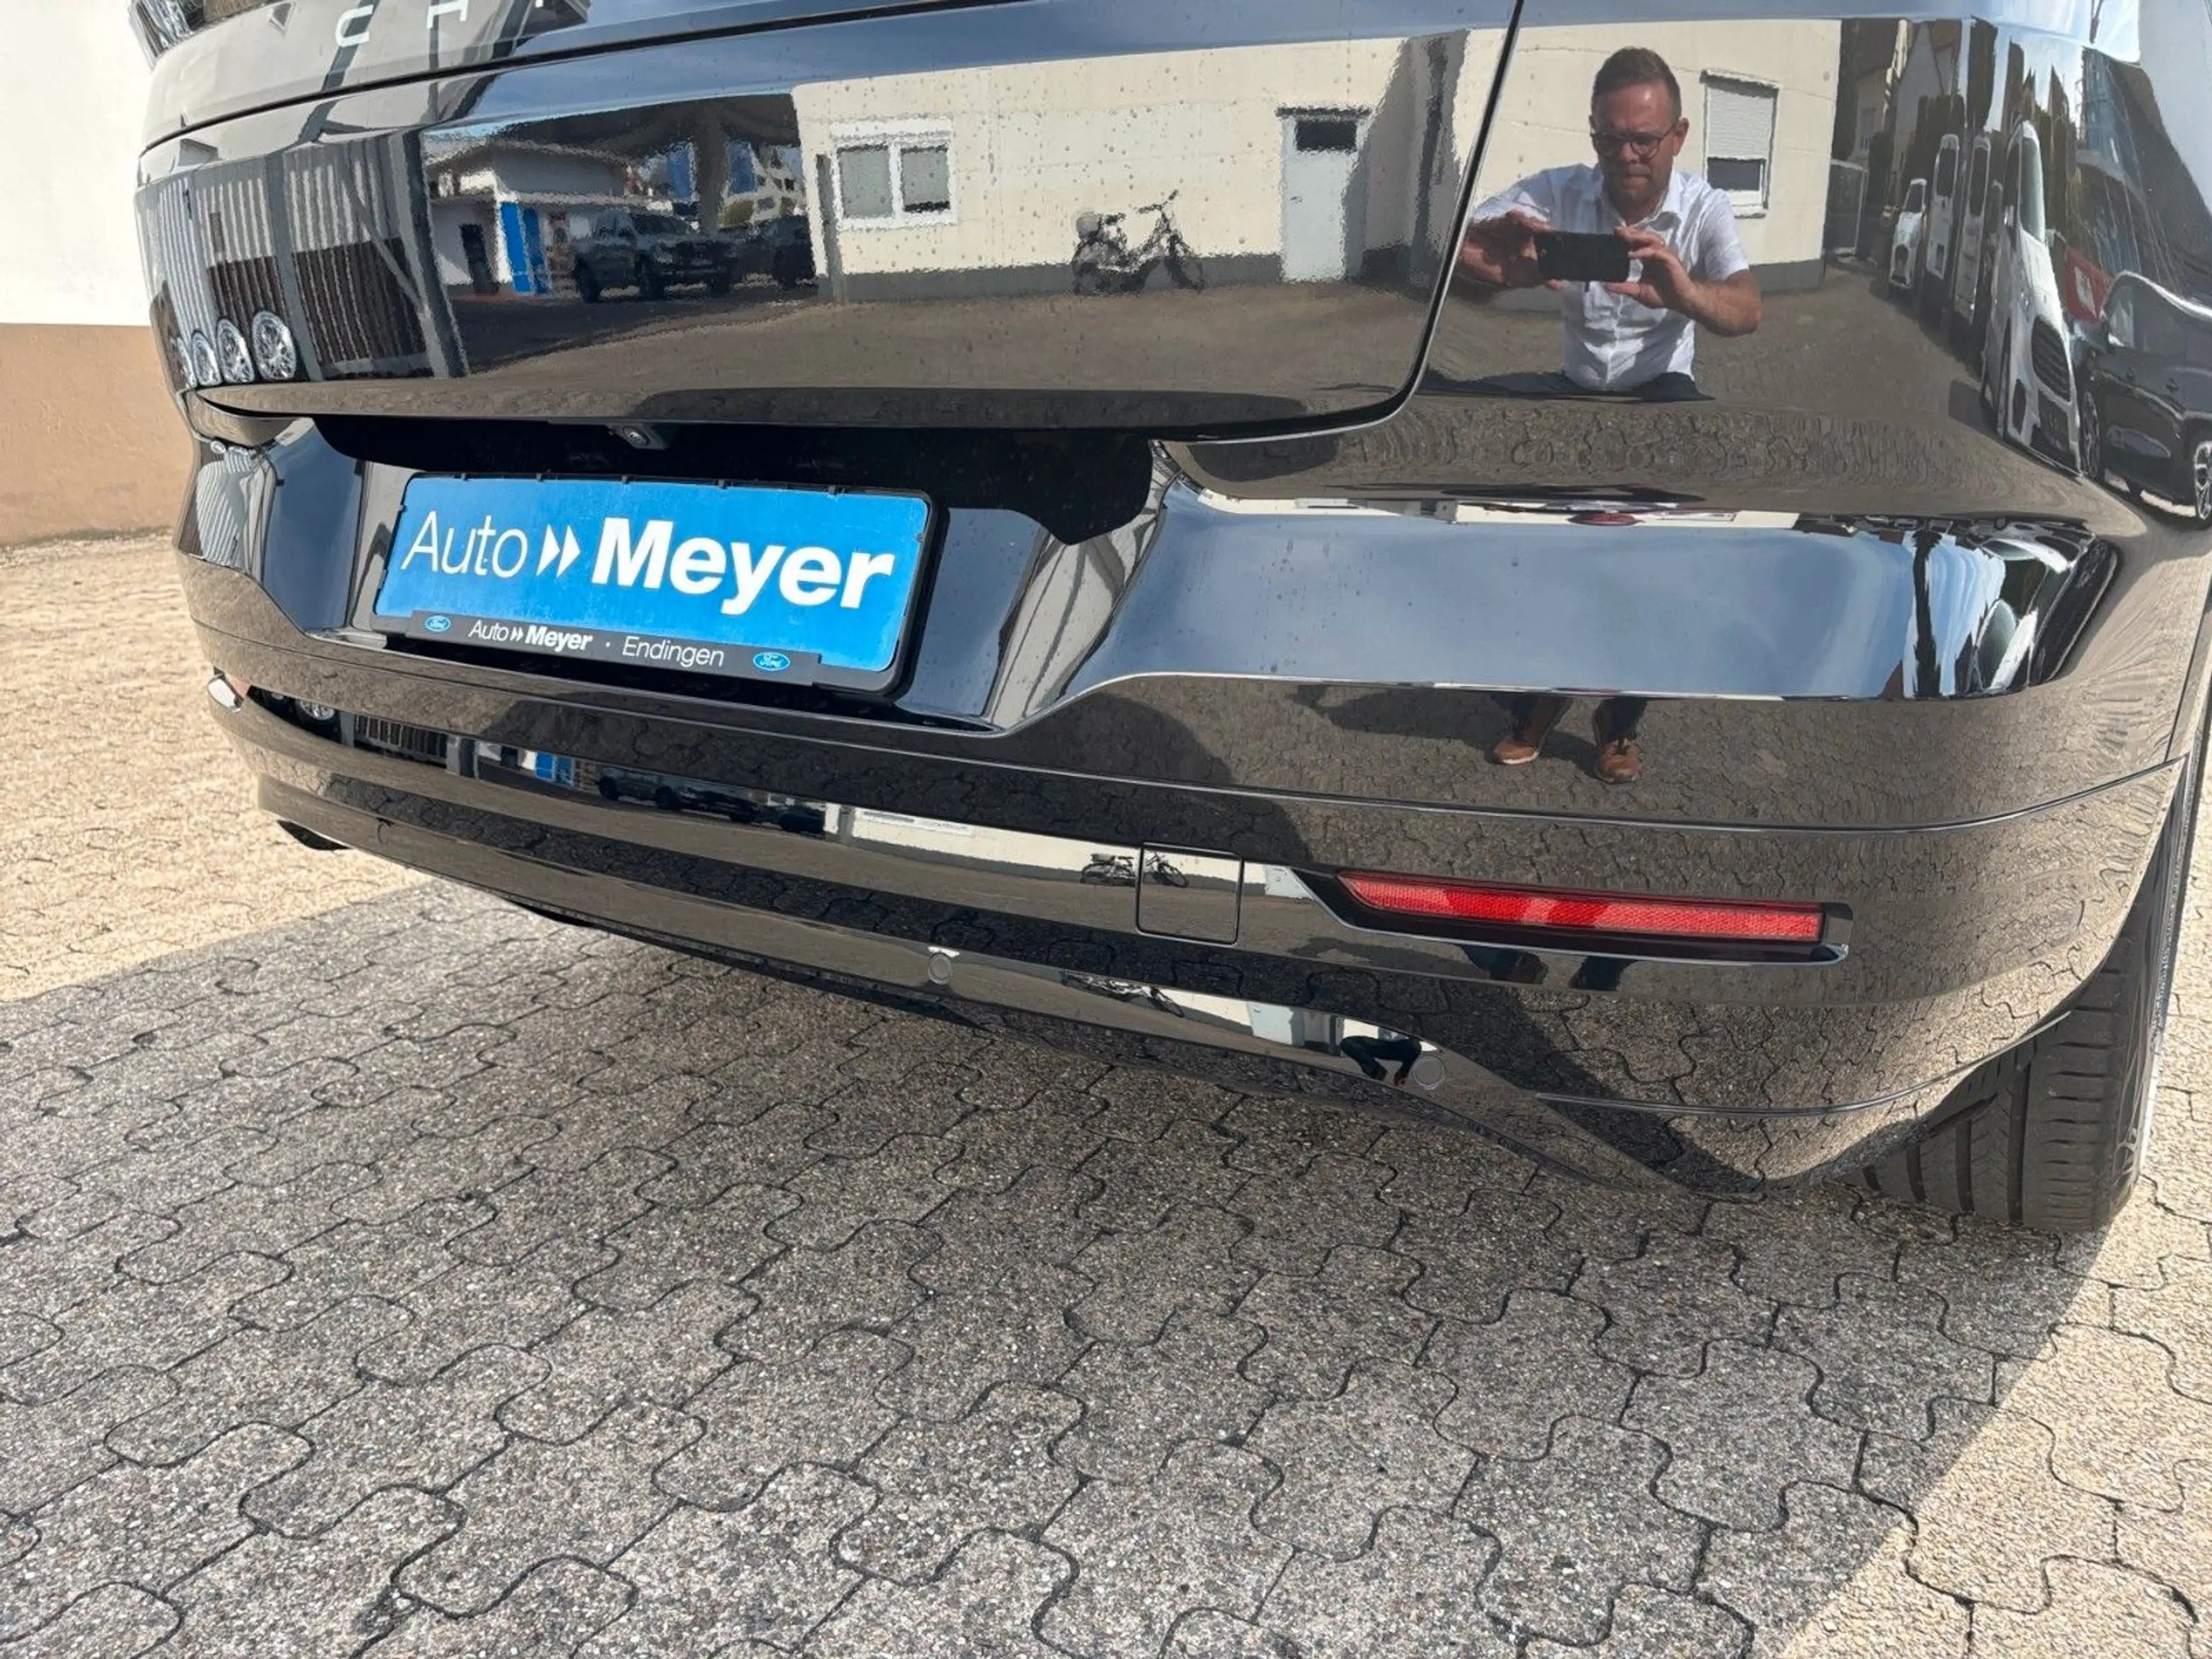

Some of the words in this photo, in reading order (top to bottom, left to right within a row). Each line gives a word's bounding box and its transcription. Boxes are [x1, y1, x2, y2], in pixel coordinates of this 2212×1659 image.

[401, 511, 528, 578] Auto
[592, 517, 895, 615] Meyer
[467, 619, 510, 642] Auto
[523, 624, 594, 653] Meyer
[622, 635, 725, 669] Endingen
